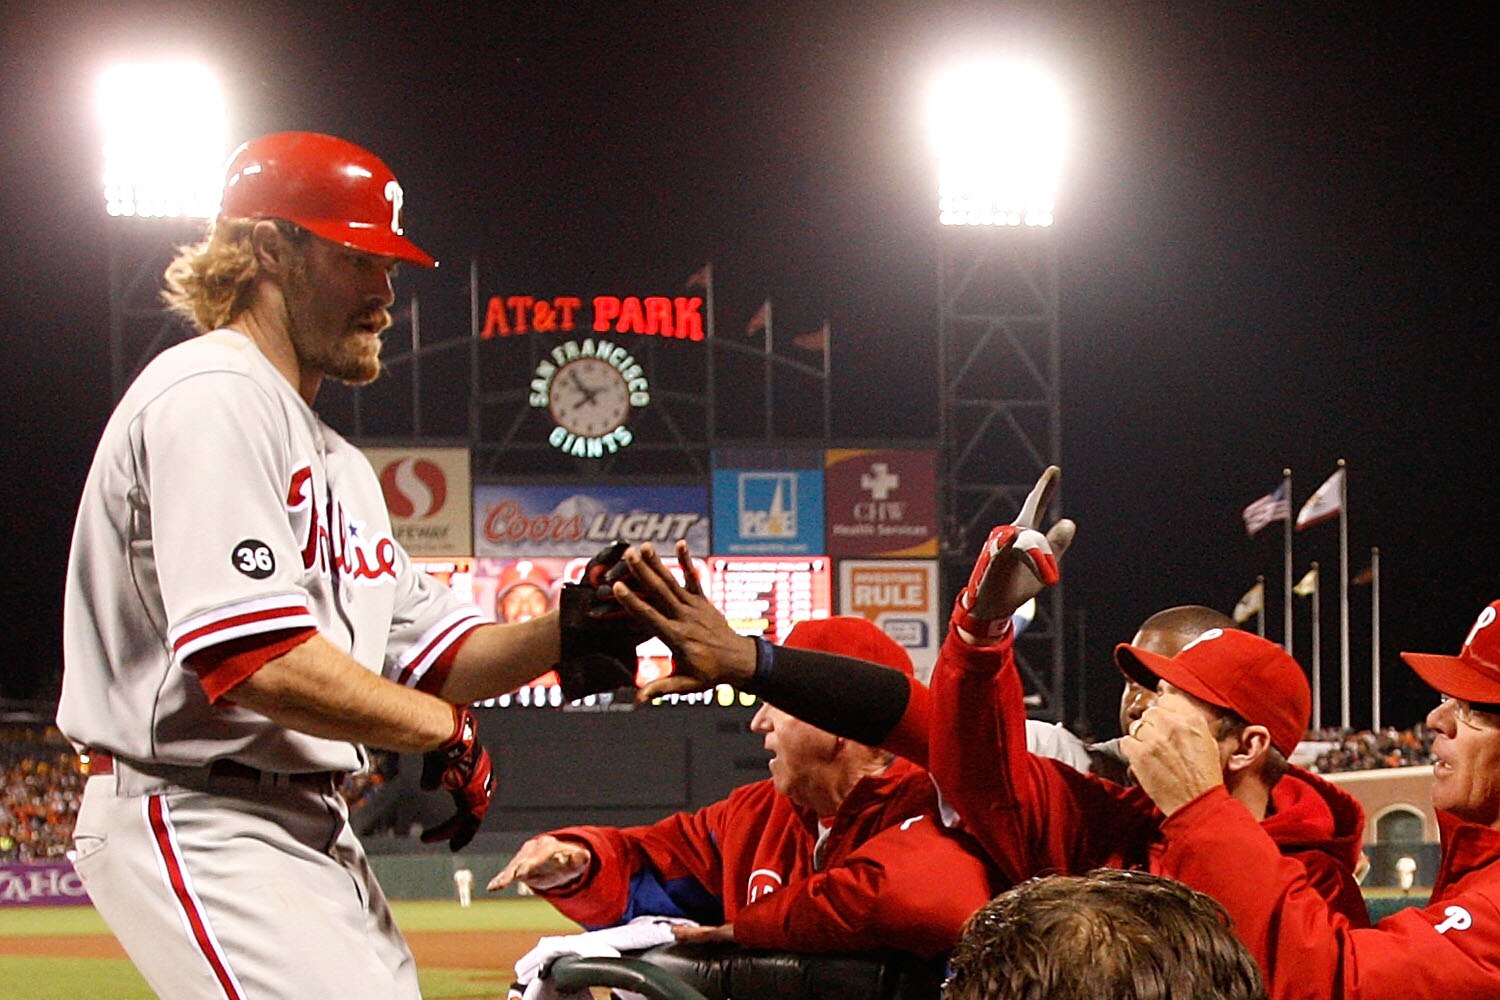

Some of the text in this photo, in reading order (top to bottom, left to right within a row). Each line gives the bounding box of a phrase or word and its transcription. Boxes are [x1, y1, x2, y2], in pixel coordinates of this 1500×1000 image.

[384, 180, 404, 234] P
[480, 294, 705, 342] AT&T PARK
[528, 337, 651, 408] SAN FRANCISCO
[548, 425, 633, 458] GIANTS
[482, 499, 700, 545] Coors LIGHT
[236, 546, 273, 573] 36
[853, 584, 924, 607] RULE
[1465, 606, 1497, 647] P
[1433, 904, 1473, 935] P
